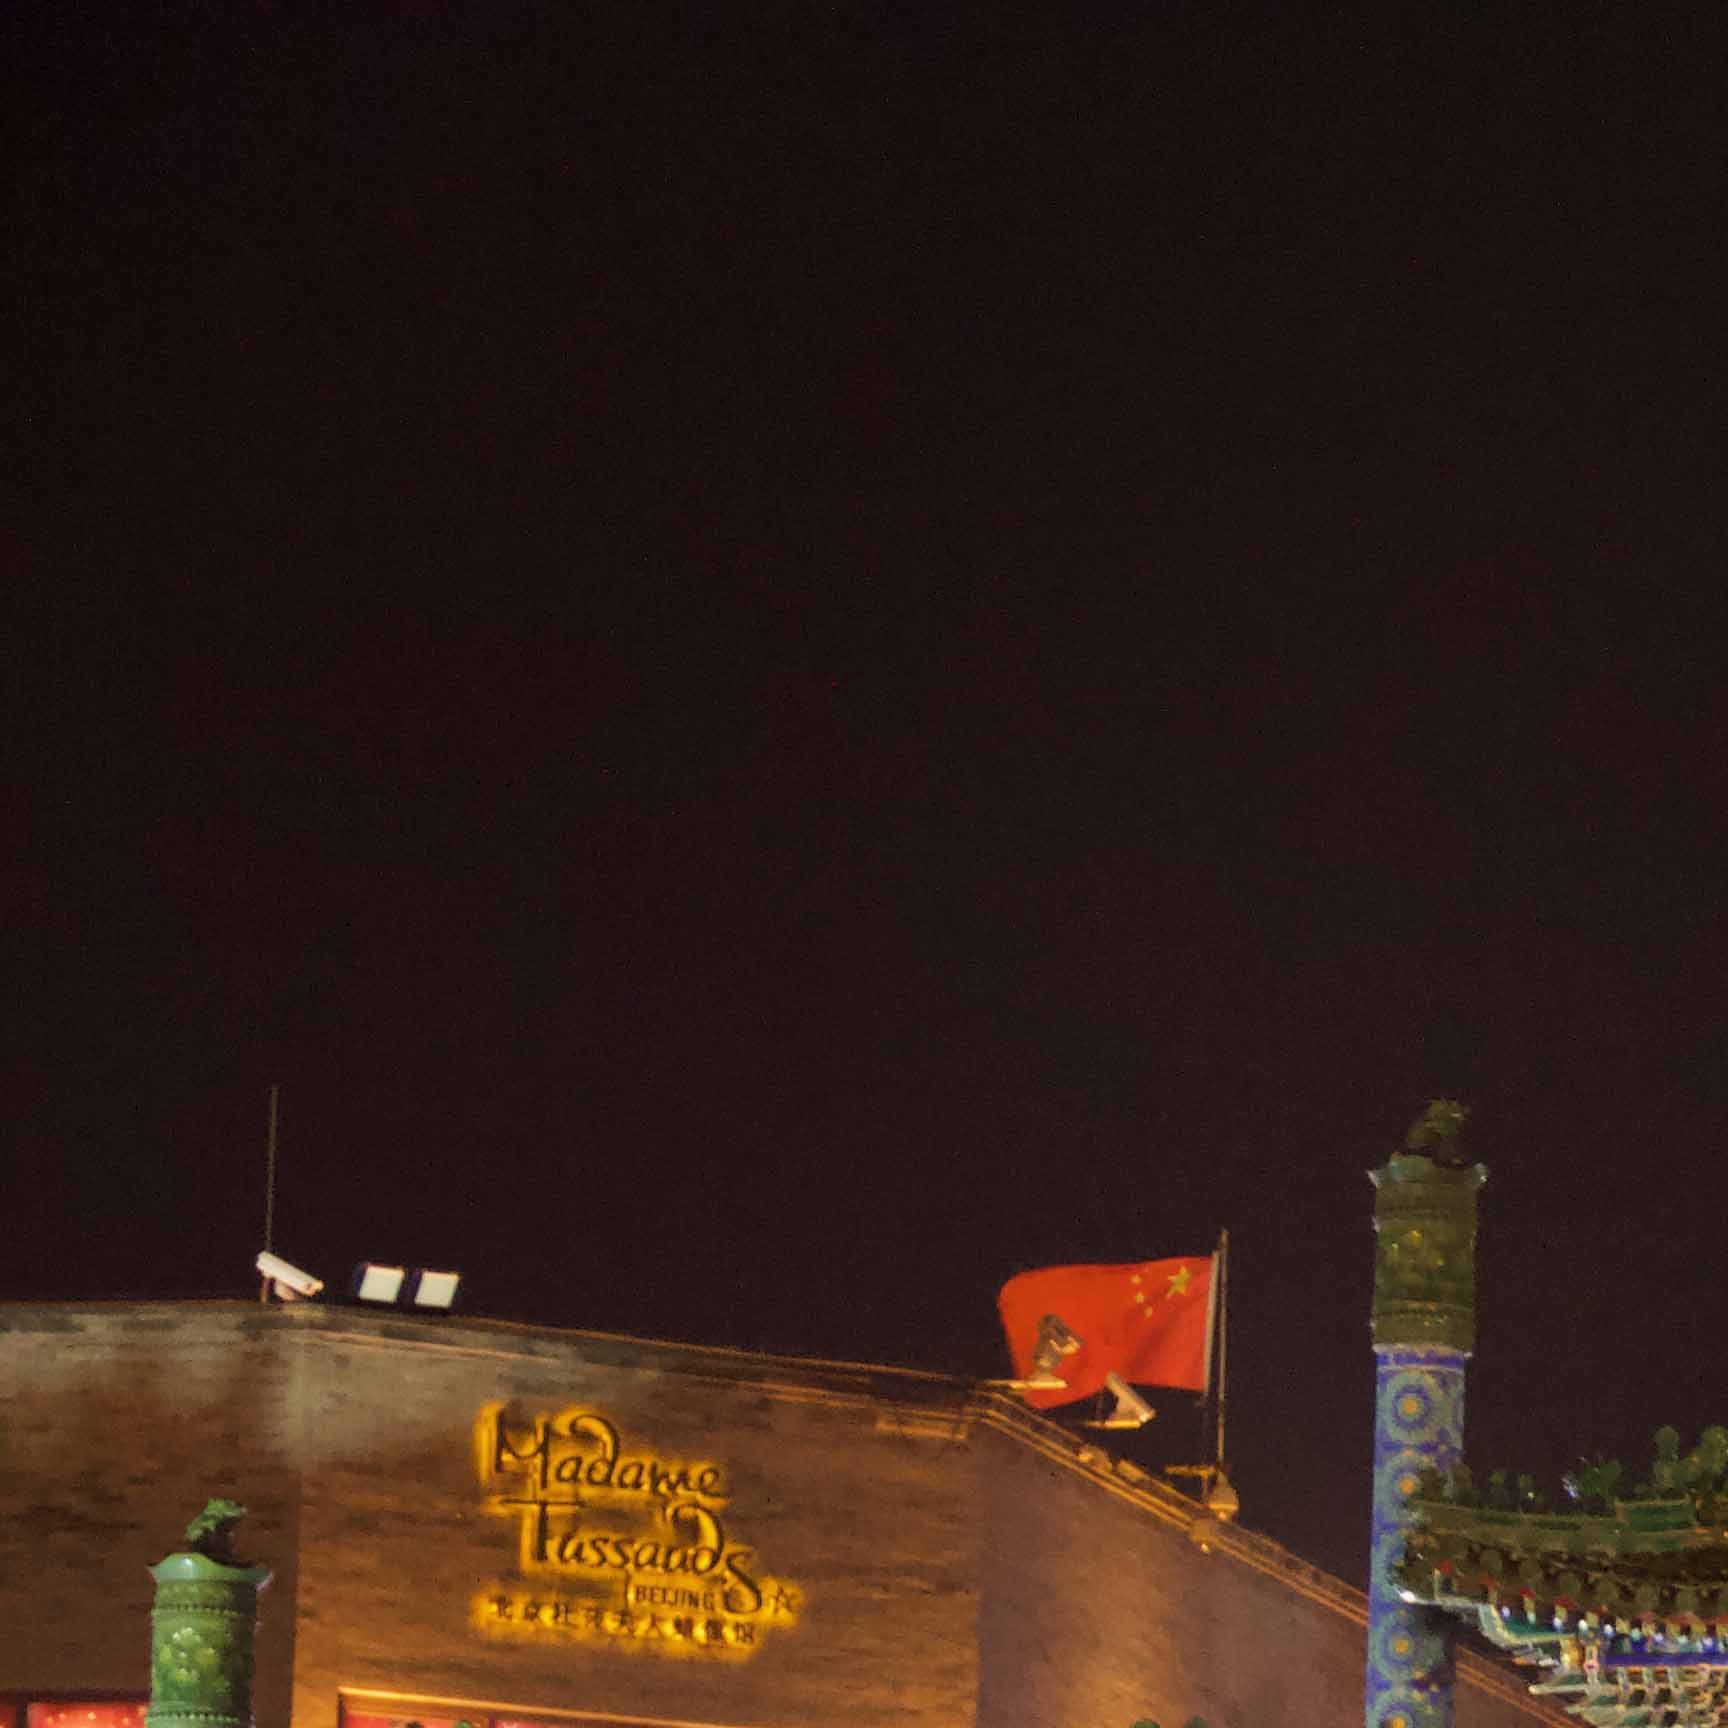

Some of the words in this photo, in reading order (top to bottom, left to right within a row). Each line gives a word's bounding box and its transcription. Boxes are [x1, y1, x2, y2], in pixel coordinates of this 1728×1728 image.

[495, 1409, 722, 1497] Madame
[500, 1499, 763, 1614] Tussauds
[634, 1585, 715, 1611] BEIJING
